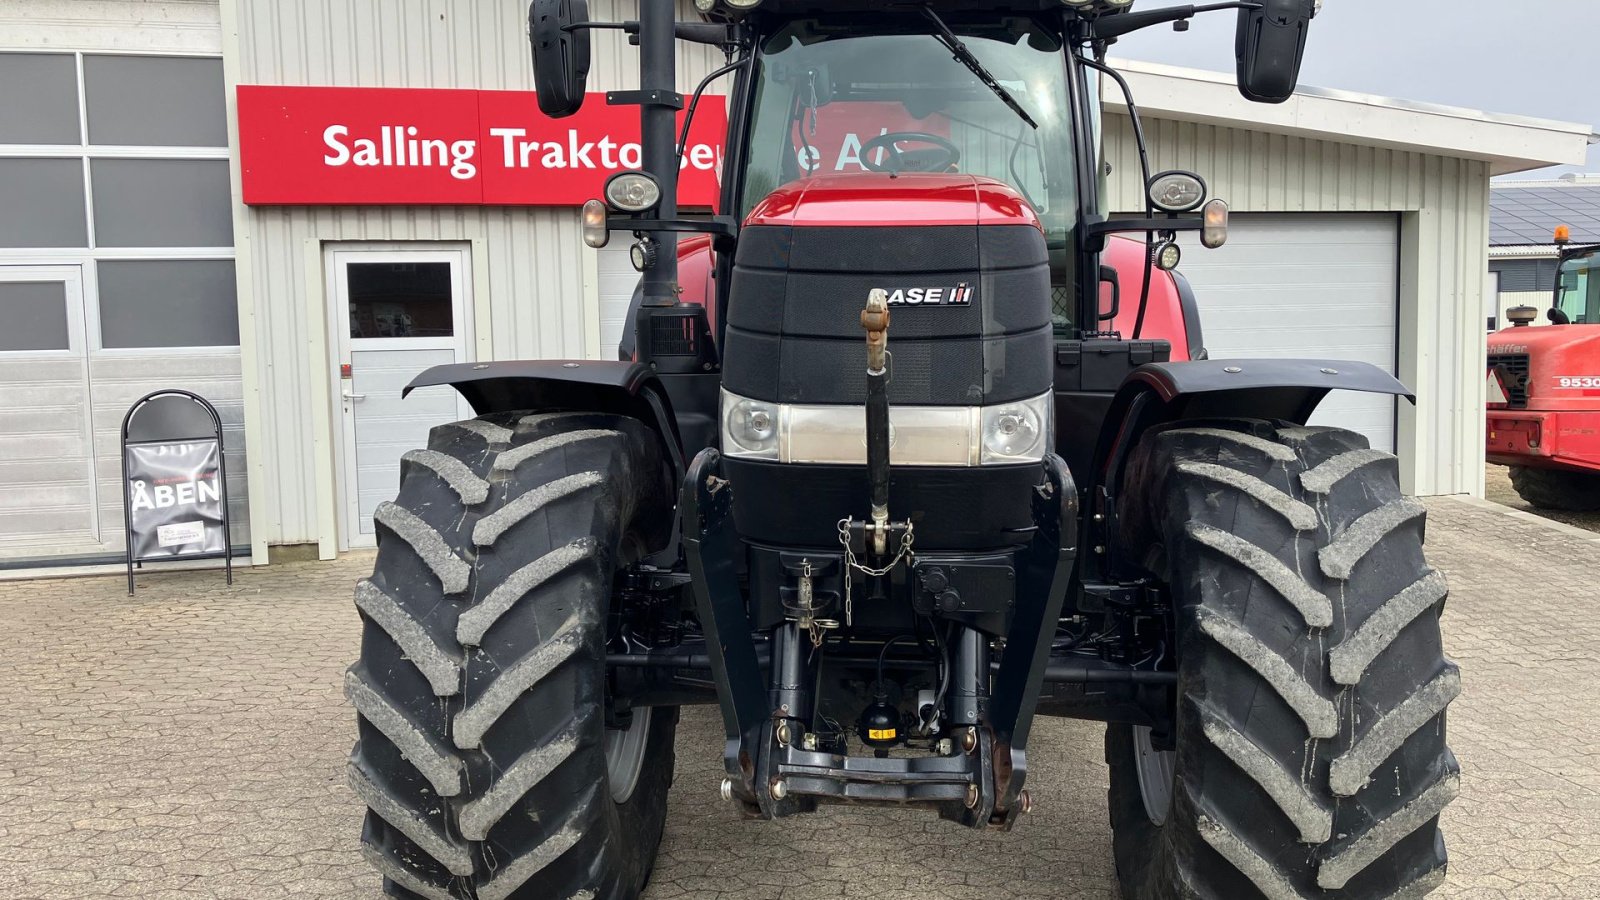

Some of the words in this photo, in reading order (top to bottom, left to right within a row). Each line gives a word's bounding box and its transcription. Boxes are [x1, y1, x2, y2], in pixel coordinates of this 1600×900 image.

[322, 124, 476, 179] Salling
[1559, 378, 1600, 388] 9530
[132, 479, 220, 512] ÅBEN
